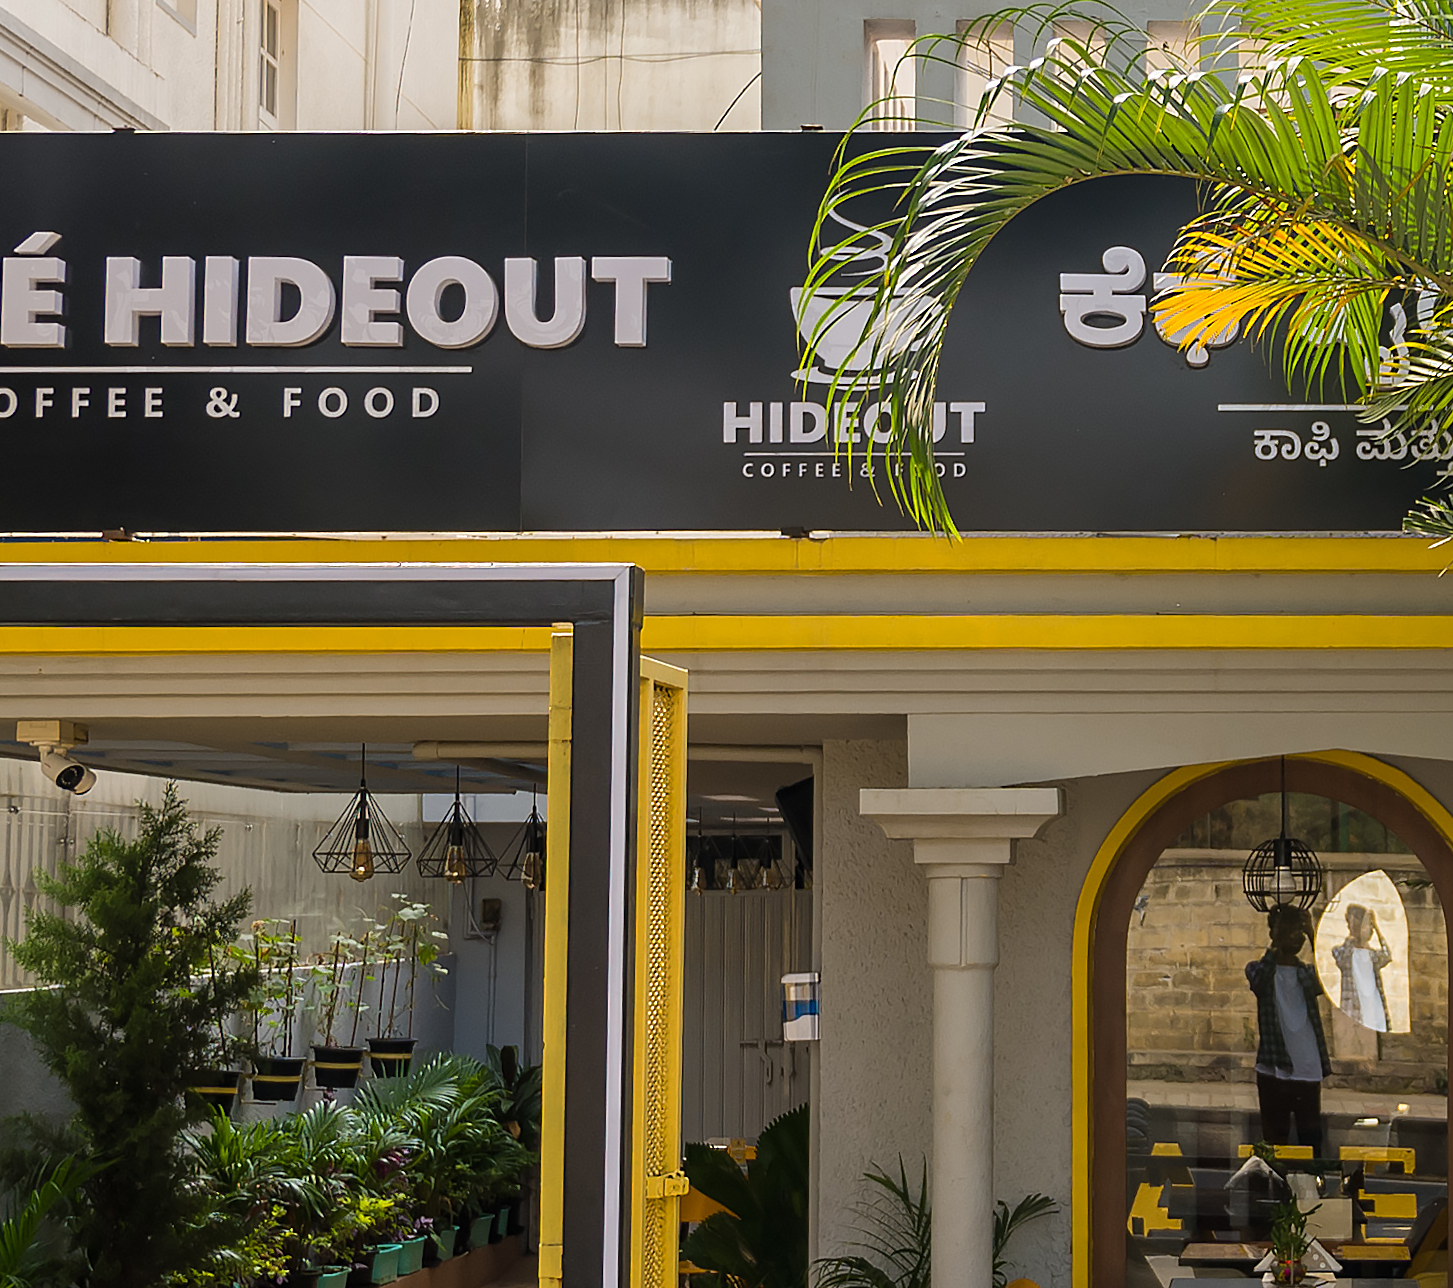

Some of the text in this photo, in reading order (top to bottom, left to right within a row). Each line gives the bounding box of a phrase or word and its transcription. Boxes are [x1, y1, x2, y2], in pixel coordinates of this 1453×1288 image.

[104, 255, 673, 350] HIDEOUT
[204, 387, 241, 420] &
[283, 385, 441, 419] FOOD
[1253, 420, 1341, 467] ಕಾಫಿ
[741, 462, 967, 478] COFFEE & FOD
